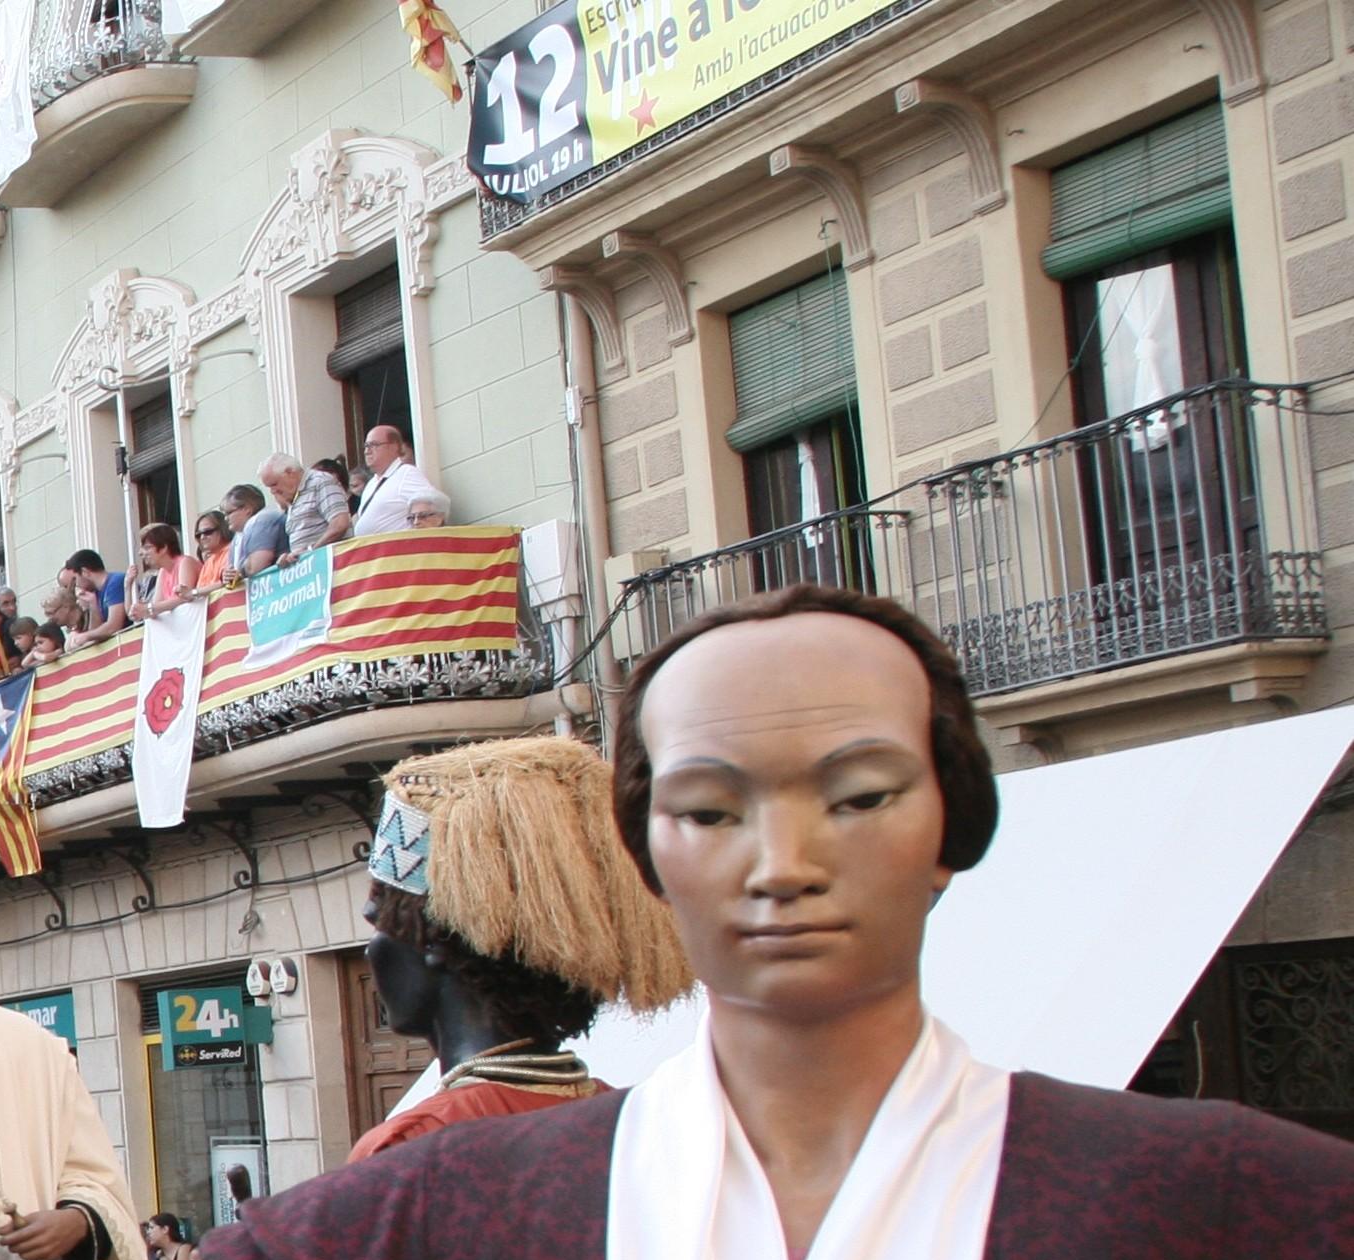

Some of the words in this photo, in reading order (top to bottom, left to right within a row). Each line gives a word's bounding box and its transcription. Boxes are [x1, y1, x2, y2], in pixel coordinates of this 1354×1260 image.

[594, 16, 679, 96] Vine
[688, 0, 711, 42] a
[693, 48, 733, 91] Amb
[482, 24, 580, 165] 12
[551, 146, 570, 175] 19
[573, 138, 584, 164] h
[268, 573, 326, 618] normal.
[173, 995, 240, 1038] 24h
[199, 1046, 242, 1060] ServiRed
